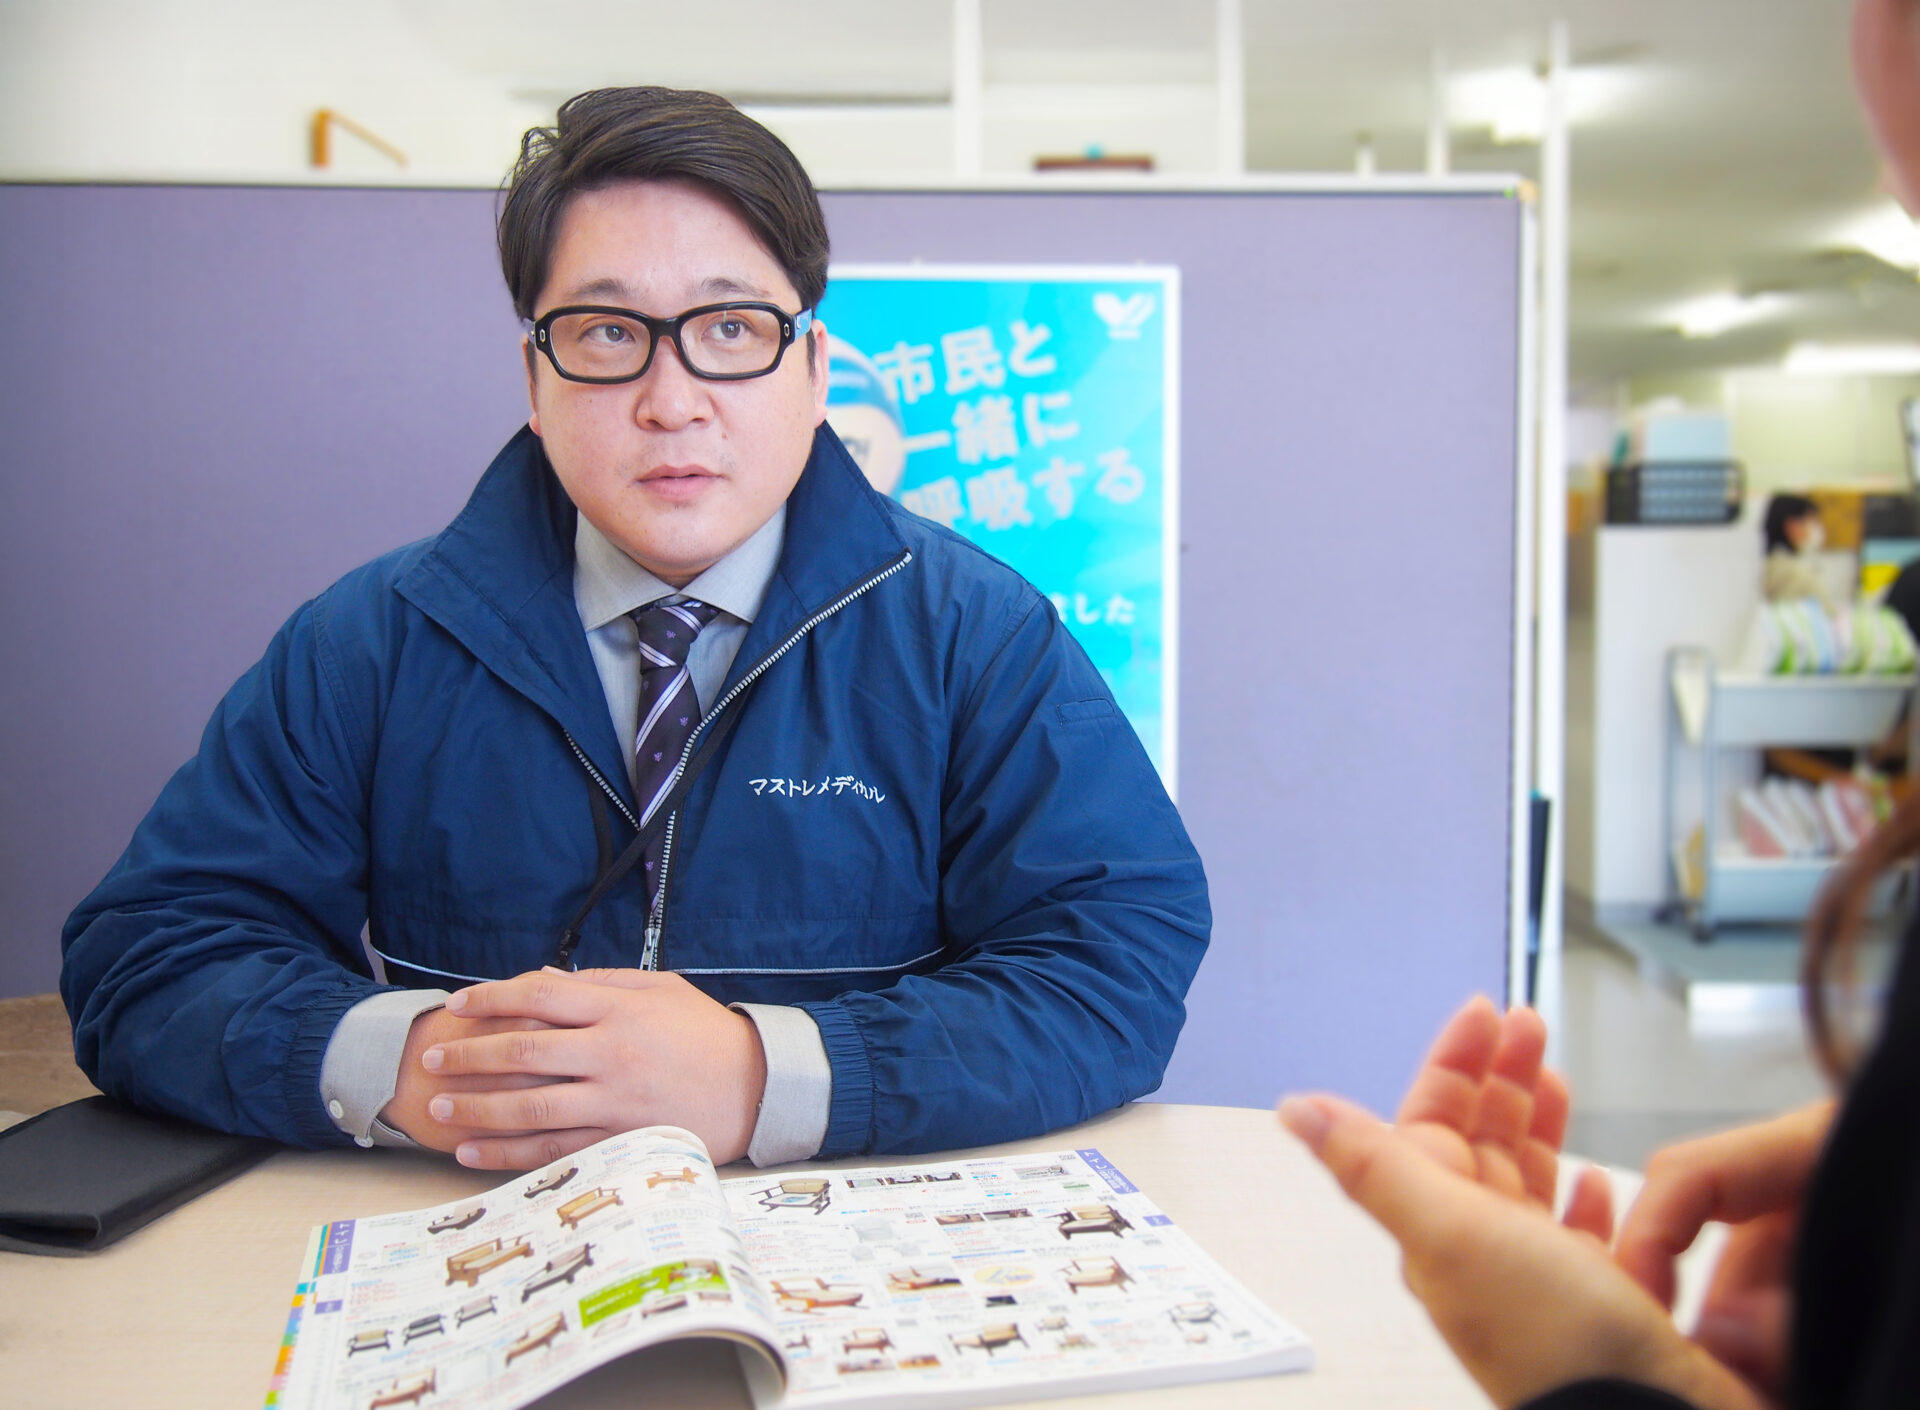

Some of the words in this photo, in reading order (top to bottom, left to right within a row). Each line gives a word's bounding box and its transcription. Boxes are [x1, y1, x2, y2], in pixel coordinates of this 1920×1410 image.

[873, 320, 1057, 404] 市民と
[902, 391, 1080, 465] 一緒に
[749, 775, 886, 804] マストレメディカル
